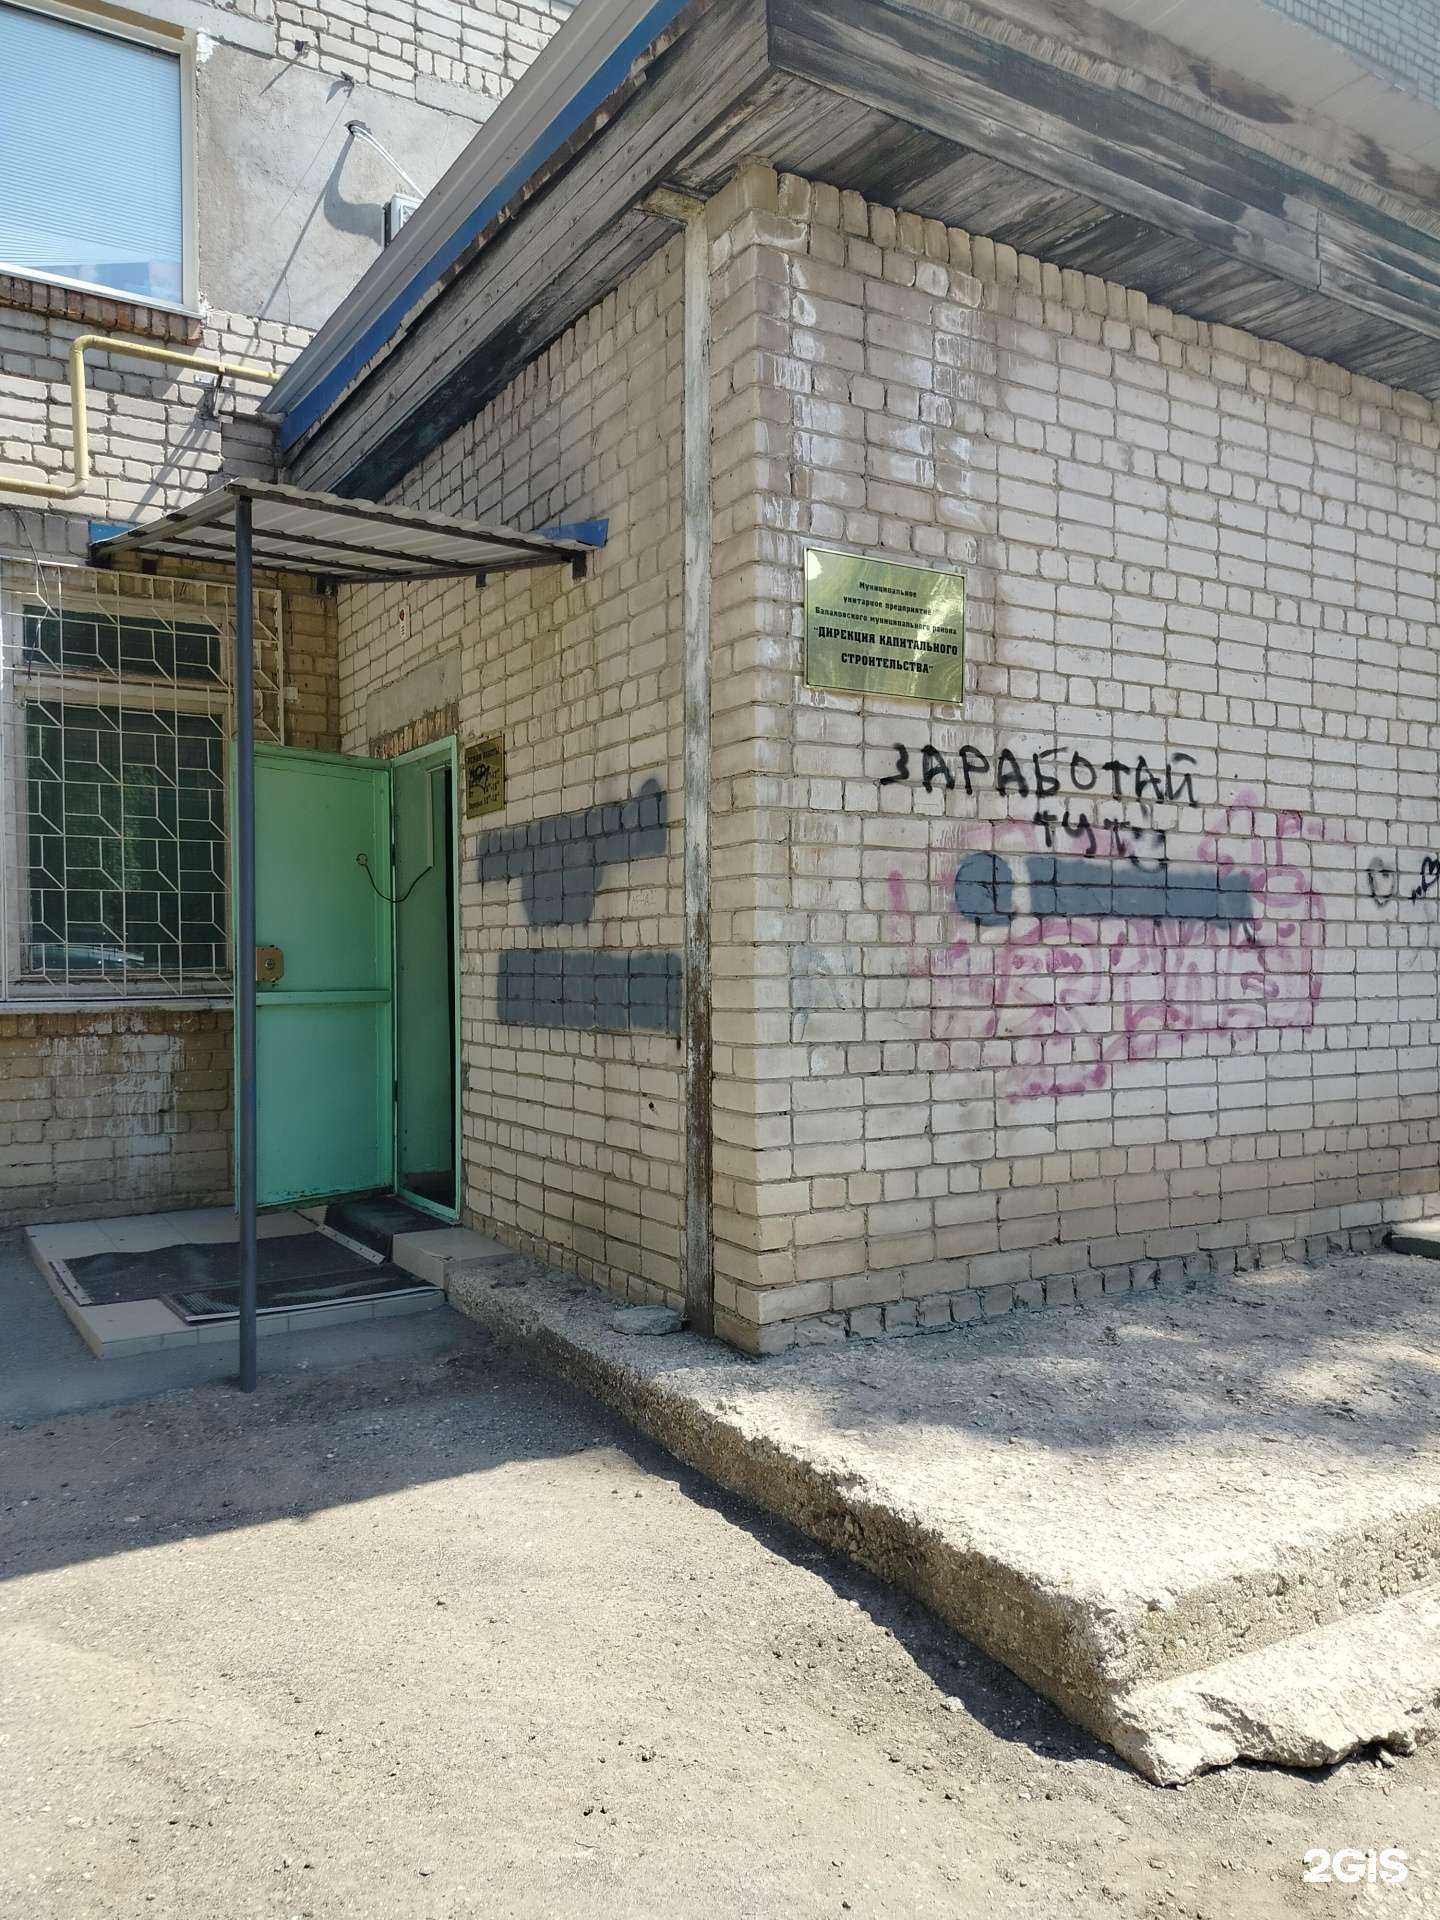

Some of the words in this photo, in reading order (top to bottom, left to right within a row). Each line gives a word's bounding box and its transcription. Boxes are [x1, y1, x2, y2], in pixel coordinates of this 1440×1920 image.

[859, 581, 917, 598] Муниципальное
[843, 595, 883, 608] унитарное
[815, 606, 868, 622] Балаковского
[870, 616, 931, 632] муниципального
[932, 626, 957, 635] района
[879, 635, 958, 655] КАПИТАЛЬНОГО
[880, 743, 1198, 807] ЗАРАБОТАЙ
